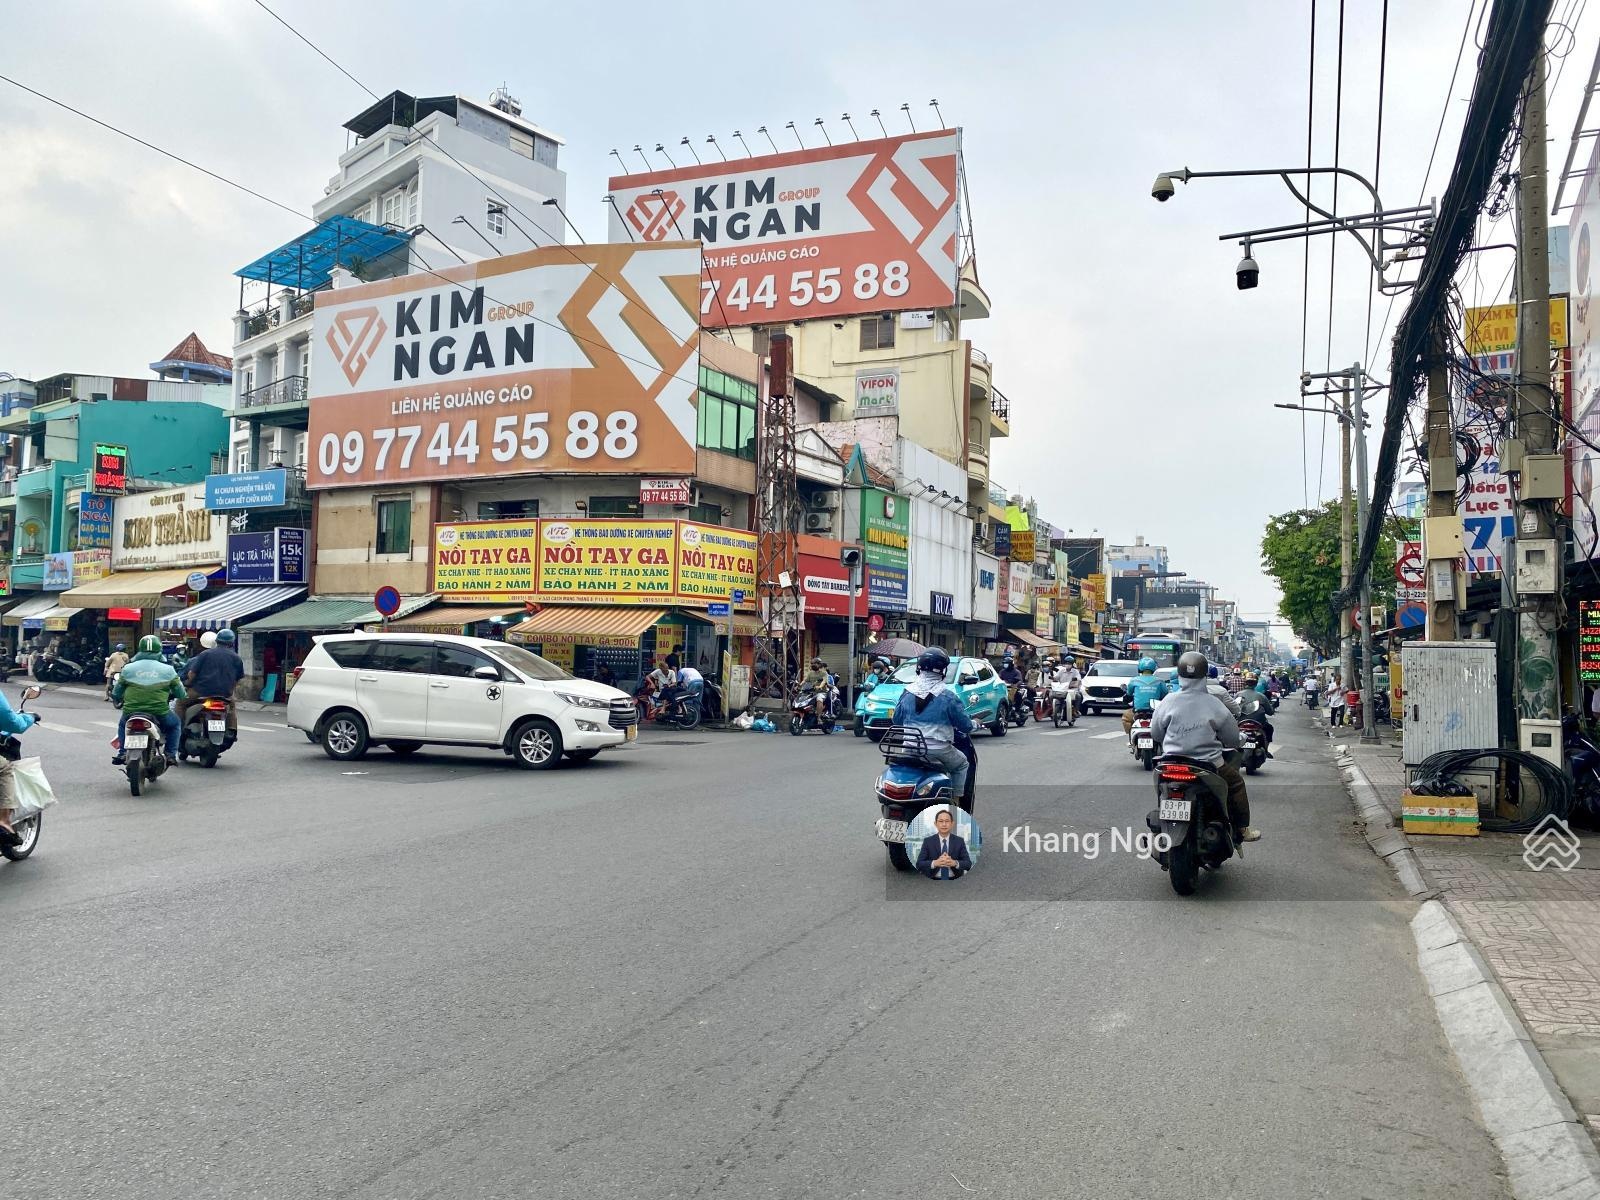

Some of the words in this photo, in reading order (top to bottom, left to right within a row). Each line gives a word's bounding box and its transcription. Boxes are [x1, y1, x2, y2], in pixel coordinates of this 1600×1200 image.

[694, 176, 776, 214] KIM
[778, 187, 821, 203] GROUP
[693, 202, 821, 243] NGAN
[720, 252, 738, 268] HỆ
[740, 248, 787, 266] QUẢNG
[789, 246, 820, 261] CÁO
[726, 273, 777, 312] 44
[789, 267, 841, 307] 55
[853, 260, 910, 300] 88
[396, 286, 485, 338] KIM
[487, 301, 534, 322] GROUP
[1478, 309, 1500, 322] KIM
[393, 322, 535, 381] NGAN
[860, 377, 894, 390] VIFON
[391, 395, 420, 416] LIÊN
[423, 392, 441, 414] HỆ
[444, 384, 495, 411] QUẢNG
[499, 384, 533, 404] CÁO
[318, 431, 364, 475] 09
[373, 425, 422, 470] 77
[426, 420, 479, 466] 44
[491, 413, 550, 462] 55
[565, 410, 638, 460] 88
[642, 491, 651, 502] 09
[652, 491, 660, 502] 77
[661, 491, 669, 501] 44
[670, 491, 678, 501] 55
[679, 490, 687, 501] 88
[1465, 500, 1500, 514] Lục
[280, 544, 303, 556] 15k
[438, 543, 467, 566] NỒI
[470, 548, 503, 565] TAY
[506, 547, 532, 564] GA
[544, 540, 583, 564] NỒI
[588, 547, 633, 565] TAY
[637, 548, 670, 565] GA
[681, 545, 706, 568] NỒI
[709, 553, 735, 571] TAY
[737, 557, 755, 574] GA
[438, 569, 447, 577] XE
[543, 567, 557, 576] XE
[681, 570, 689, 578] XE
[495, 581, 502, 589] 2
[622, 581, 632, 590] 2
[935, 594, 954, 615] RUZA
[526, 634, 558, 643] COMBO
[580, 636, 597, 644] TAY
[599, 637, 611, 646] GA
[613, 638, 636, 647] 900K
[1164, 801, 1187, 810] 63-P1
